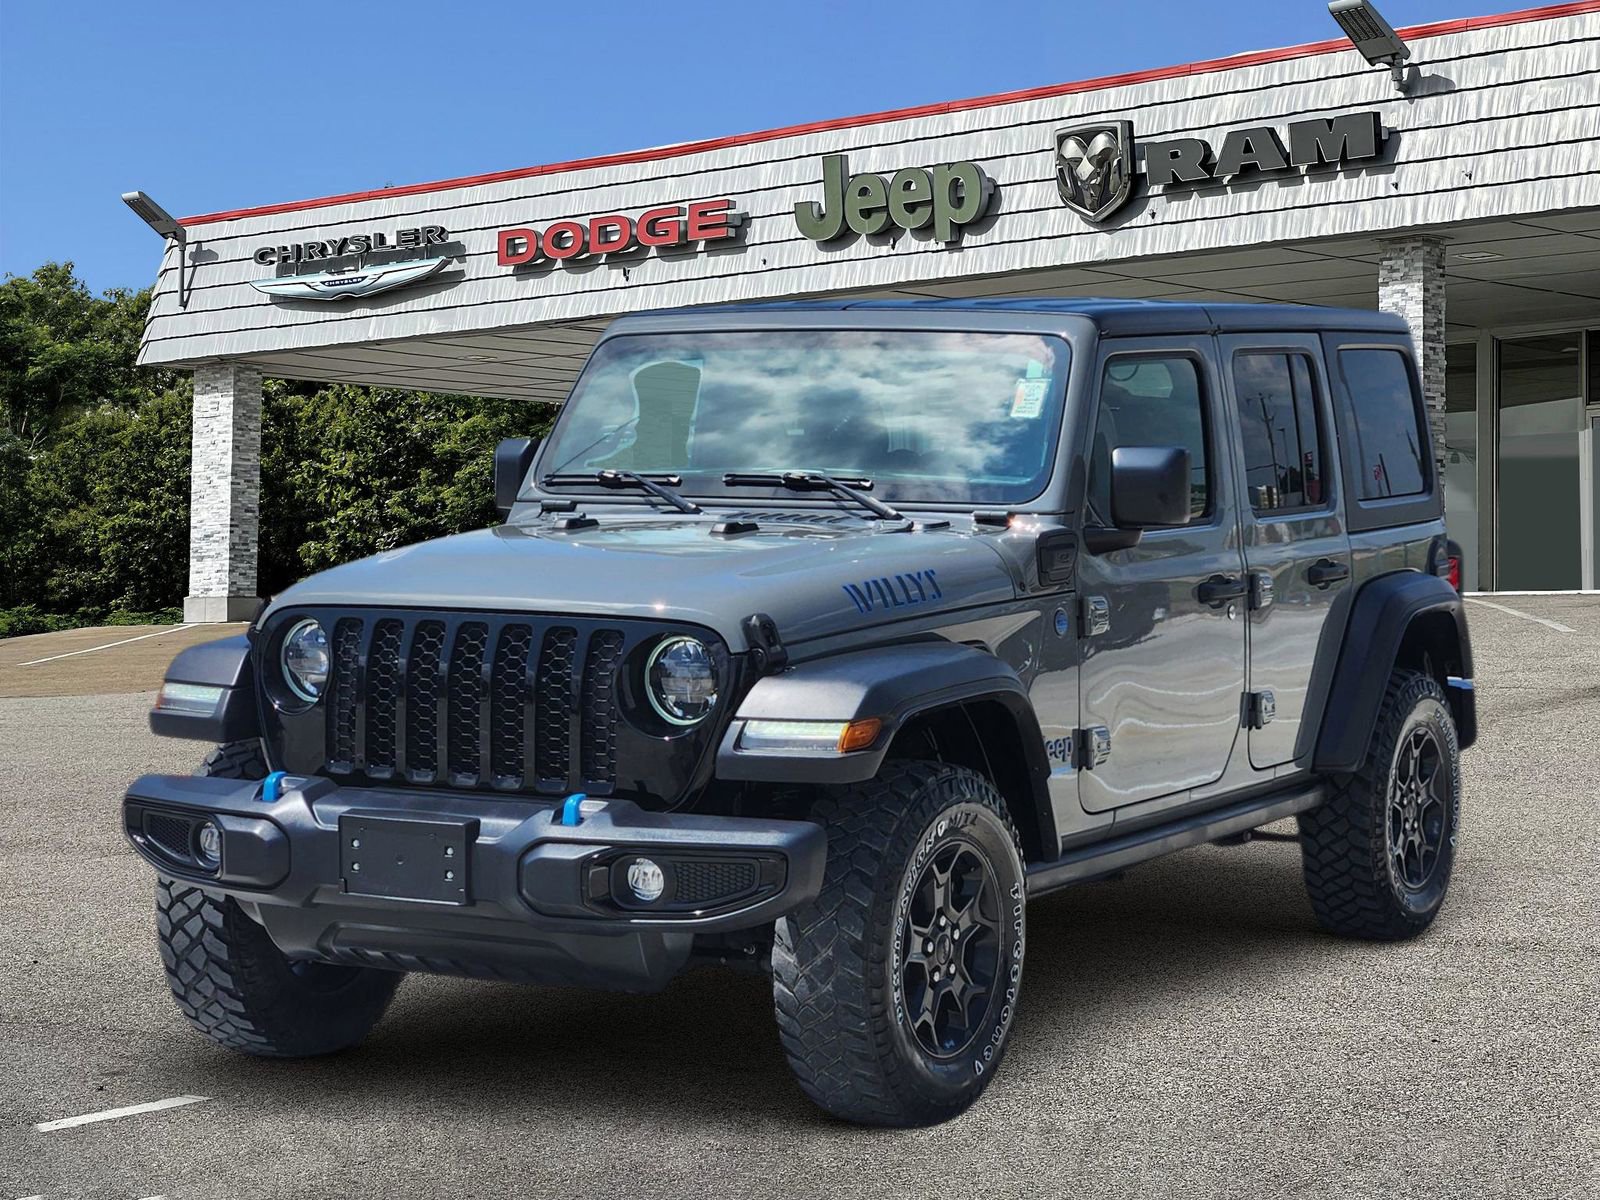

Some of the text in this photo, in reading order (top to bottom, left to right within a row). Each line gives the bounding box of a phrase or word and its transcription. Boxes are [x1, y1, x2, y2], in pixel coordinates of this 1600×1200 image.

[1145, 111, 1380, 186] RAM
[794, 154, 986, 243] Jeep
[253, 225, 448, 266] CHRYSLER
[498, 199, 736, 266] DODGE
[324, 278, 362, 287] CHRYSLER
[842, 568, 943, 613] WILLYS
[1044, 736, 1074, 762] eep
